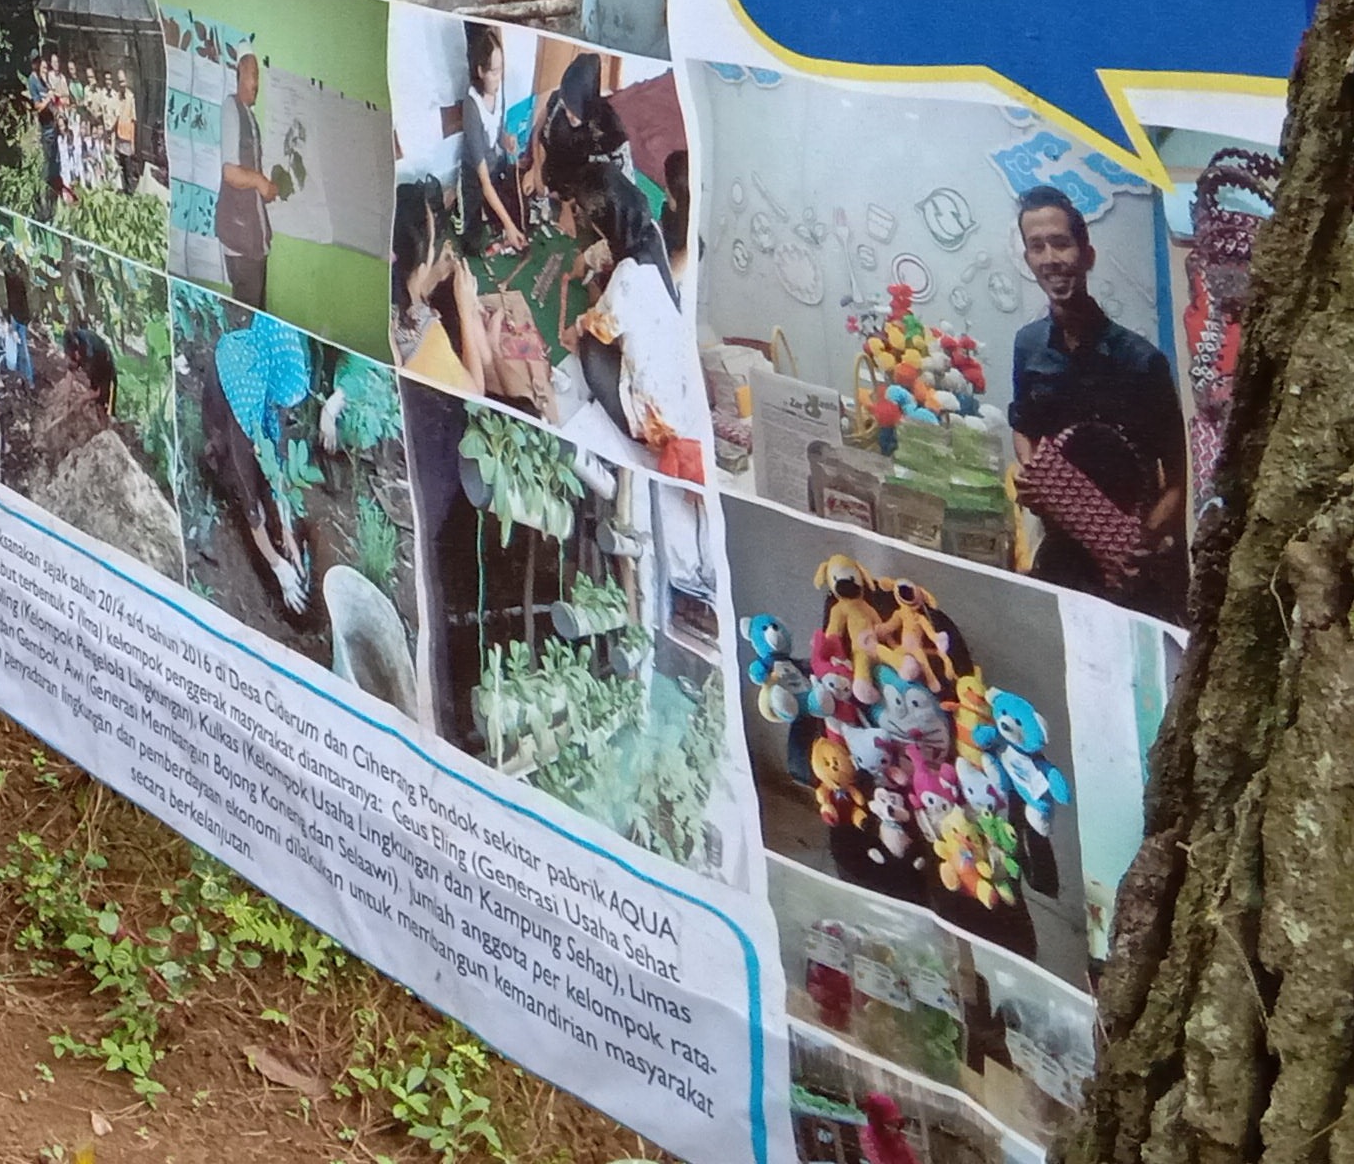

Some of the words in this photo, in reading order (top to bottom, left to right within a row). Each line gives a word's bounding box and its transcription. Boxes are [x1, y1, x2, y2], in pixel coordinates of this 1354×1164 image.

[16, 627, 60, 670] Gembok
[86, 672, 138, 720] (Generasi
[141, 705, 210, 768] Membangun
[213, 752, 258, 805] Bojong
[308, 821, 334, 851] dan
[408, 877, 455, 930] Jumlah
[461, 917, 528, 972] anggota
[533, 958, 561, 991] per
[566, 976, 664, 1049] kelompok
[670, 1036, 718, 1075] rata-
[19, 573, 66, 616] terbentuk
[68, 601, 76, 620] 5
[78, 606, 103, 644] (lima)
[106, 626, 163, 676] kelompok
[165, 667, 227, 716] penggerak
[230, 705, 295, 762] masyarakat
[298, 750, 383, 814] diantaranya:
[431, 824, 468, 873] Eling
[472, 851, 559, 916] (Generasi
[563, 897, 620, 951] Usaha
[624, 934, 681, 984] Sehat
[21, 599, 74, 650] (Kelompok
[76, 634, 125, 682] Pengelola
[199, 711, 239, 754] Kulkas
[242, 742, 309, 804] (Kelompok
[311, 787, 355, 832] Usaha
[358, 813, 439, 883] Lingkungan
[444, 871, 473, 904] dan
[479, 886, 562, 960] Kampung
[566, 936, 625, 997] Sehat),
[629, 974, 693, 1025] Limas
[43, 561, 68, 586] sejak
[70, 574, 96, 604] tahun
[98, 589, 124, 622] 2014
[127, 611, 144, 634] s/d
[146, 623, 179, 655] tahun
[180, 640, 212, 674] 2016
[215, 660, 226, 682] di
[229, 667, 262, 705] Desa
[264, 689, 319, 743] Ciderum
[324, 728, 348, 759] dan
[353, 744, 417, 807] Ciherang
[419, 784, 479, 839] Pondok
[483, 827, 541, 872] sekitar
[547, 862, 607, 908] pabrik
[608, 890, 679, 946] AQUA
[61, 684, 112, 734] lingkungan
[116, 722, 136, 750] dan
[139, 741, 222, 805] pemberdayaan
[225, 798, 281, 846] ekonomi
[285, 837, 343, 891] dilakukan
[349, 881, 393, 921] untuk
[397, 908, 489, 983] membangun
[494, 964, 598, 1052] kemandirian
[605, 1039, 715, 1120] masyarakat
[130, 767, 166, 803] secara
[169, 792, 254, 861] berkelanjutan.
